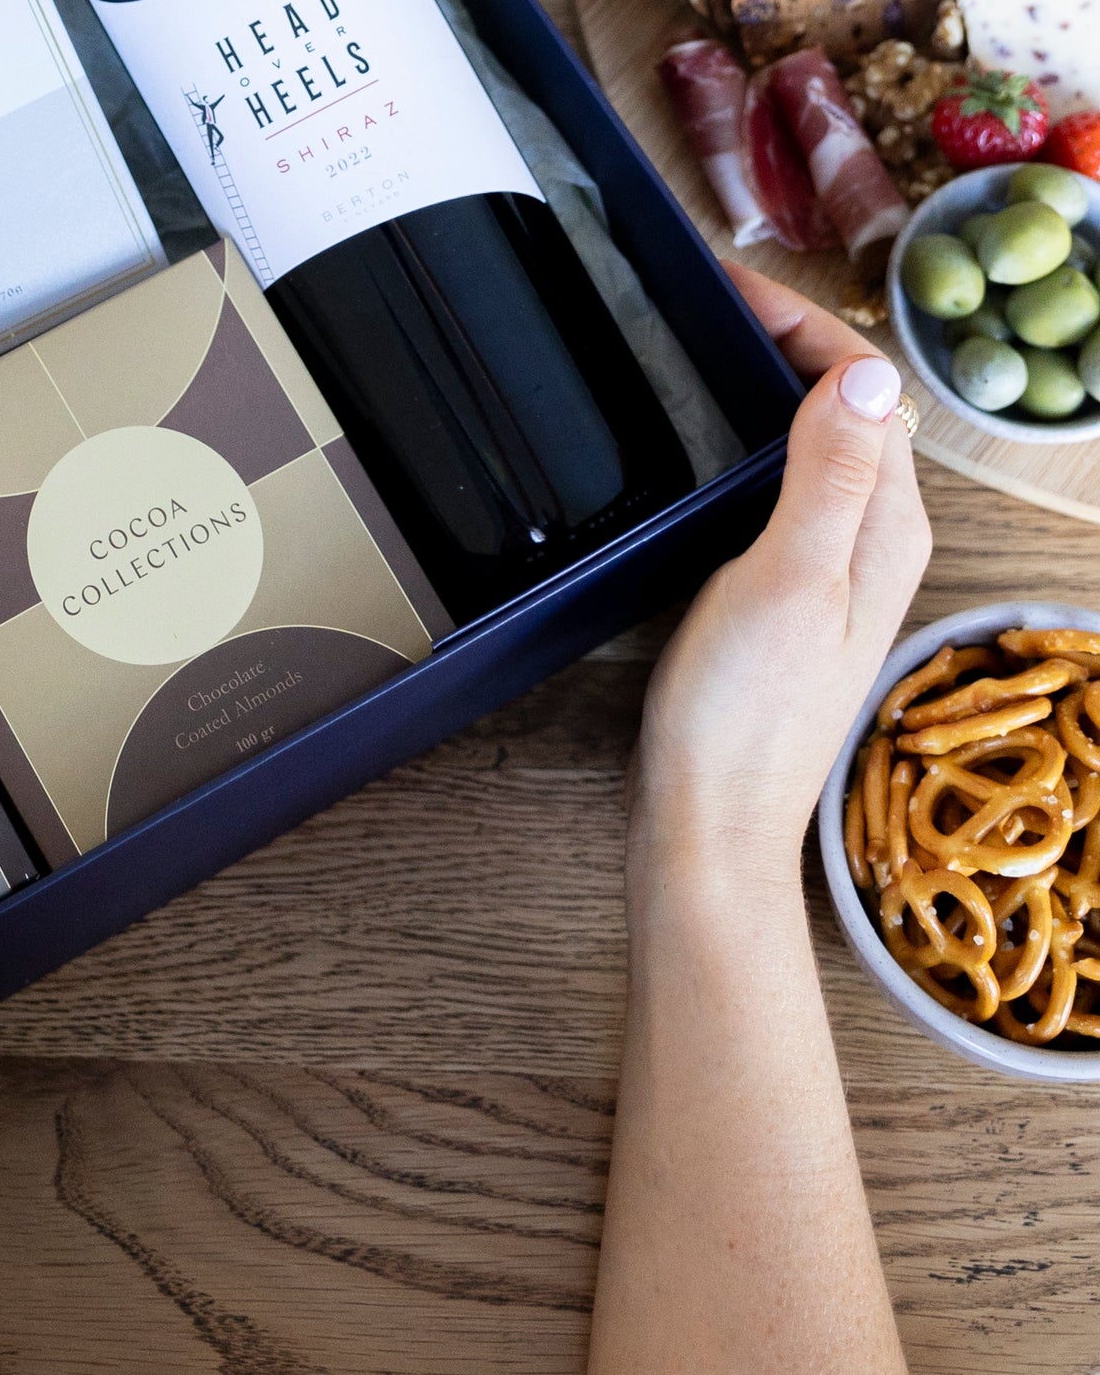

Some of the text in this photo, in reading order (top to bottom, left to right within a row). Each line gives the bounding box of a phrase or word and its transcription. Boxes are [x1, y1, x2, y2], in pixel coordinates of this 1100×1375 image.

[240, 26, 346, 87] OVER
[245, 42, 370, 129] HEELS
[276, 101, 399, 174] SHIRAZ
[325, 146, 373, 178] 2022
[322, 170, 410, 222] BERTON
[62, 502, 247, 616] COLLECTIONS
[89, 498, 188, 560] COCOA
[175, 671, 304, 750] Coated Almonds
[187, 660, 266, 712] Chocolate
[235, 725, 276, 753] 100 gr
